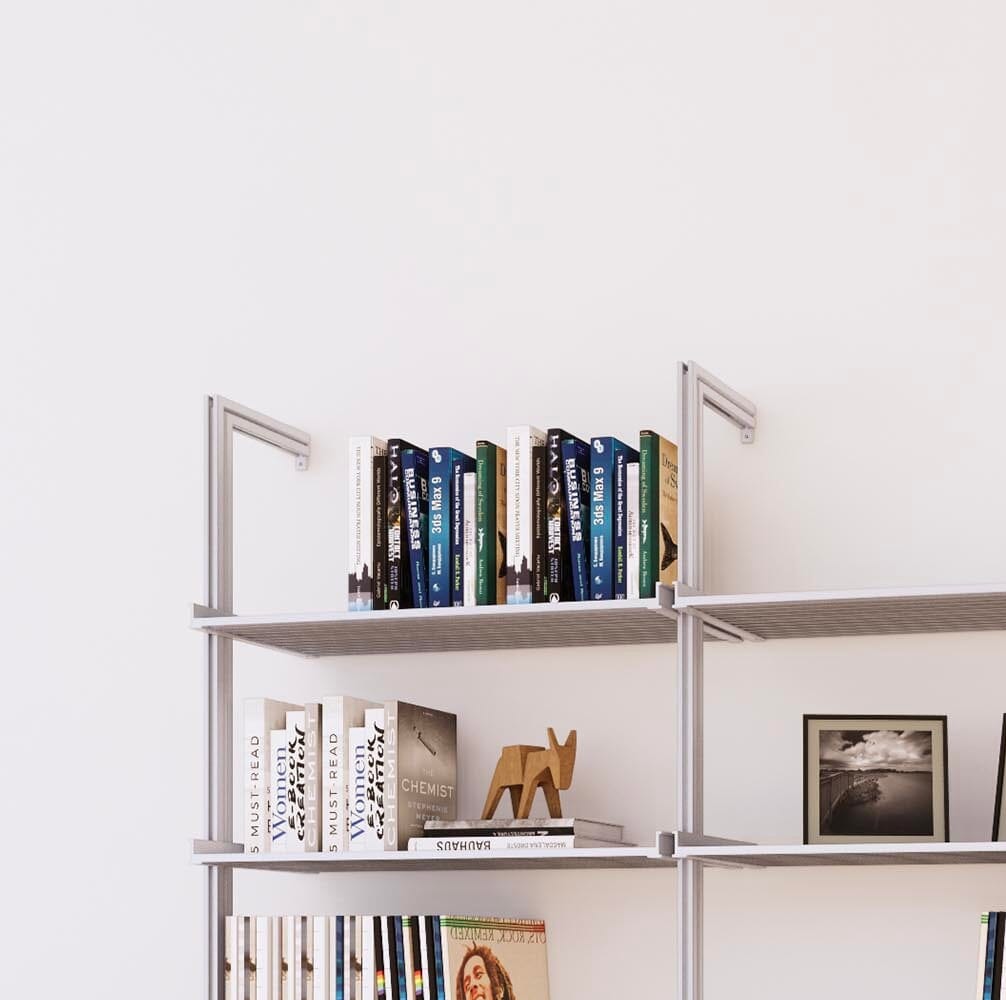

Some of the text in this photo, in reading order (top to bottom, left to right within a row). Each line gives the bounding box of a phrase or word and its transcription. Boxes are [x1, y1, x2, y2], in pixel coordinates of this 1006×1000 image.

[391, 446, 399, 504] HALO
[432, 487, 442, 512] Max
[550, 436, 560, 494] HALO
[568, 458, 582, 542] BUSINESS
[594, 478, 604, 502] Max
[408, 468, 422, 550] BUSINESS
[432, 514, 442, 534] 3ds
[594, 505, 604, 525] 3ds
[251, 736, 260, 836] MUST-READ
[272, 746, 286, 841] Women
[288, 739, 297, 829] E-BOOK
[296, 723, 306, 841] CREATION
[307, 717, 316, 847] CHEMIST
[330, 734, 338, 852] 5 MUST-READ
[350, 745, 366, 841] Women
[367, 735, 376, 828] E-BOOK
[374, 721, 384, 840] CREATION
[386, 714, 396, 846] CHEMIST
[401, 778, 454, 800] CHEMIST
[436, 840, 491, 850] BAUHAUS
